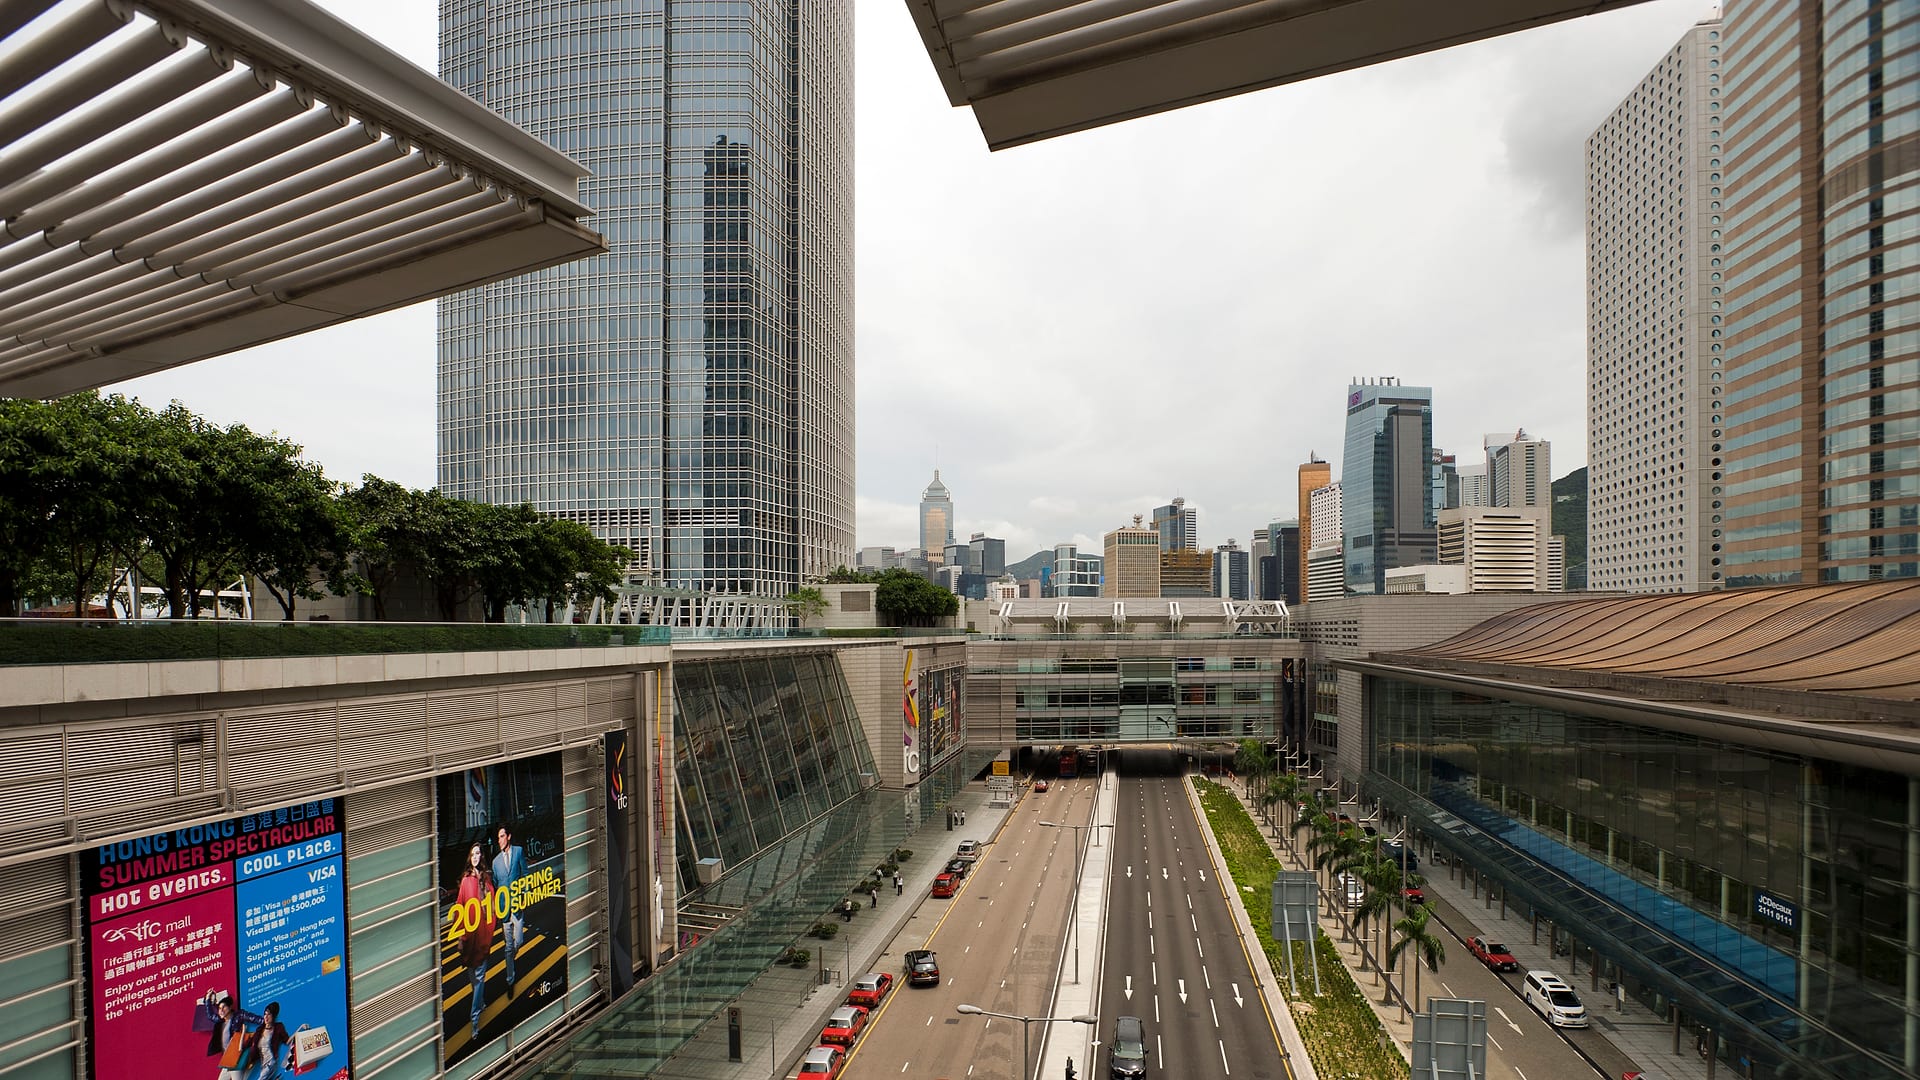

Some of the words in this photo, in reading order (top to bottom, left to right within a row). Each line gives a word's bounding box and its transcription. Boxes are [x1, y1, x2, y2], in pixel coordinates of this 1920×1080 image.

[241, 798, 335, 833] 香港夏日盛會
[468, 801, 488, 828] ifc
[99, 832, 169, 865] HONG
[175, 820, 235, 849] KONG
[99, 846, 206, 889] SUMMER
[209, 815, 336, 862] SPECTACULAR
[243, 853, 282, 875] COOL
[307, 864, 337, 883] VISA
[510, 866, 553, 897] SPRING
[510, 877, 562, 914] SUMMER
[1758, 894, 1793, 916] JCDecaux
[136, 919, 162, 942] ifc
[165, 914, 192, 933] mall
[447, 885, 511, 942] 2010
[1758, 905, 1774, 918] 2111
[1775, 912, 1793, 926] 0111
[246, 943, 263, 953] Join
[263, 939, 271, 947] in
[299, 922, 318, 934] Hong
[318, 916, 336, 927] Kong
[246, 949, 271, 963] Super
[310, 929, 325, 939] and
[246, 963, 262, 973] win
[314, 937, 330, 947] Visa
[247, 964, 286, 984] spending
[287, 949, 318, 967] amount!
[104, 980, 130, 998] Enjoy
[135, 972, 159, 987] over
[160, 964, 178, 978] 100
[179, 950, 222, 972] exclusive
[104, 985, 156, 1012] privileges
[157, 980, 168, 991] at
[169, 974, 182, 986] ifc
[183, 966, 203, 981] mall
[203, 960, 223, 974] with
[105, 1008, 124, 1021] the
